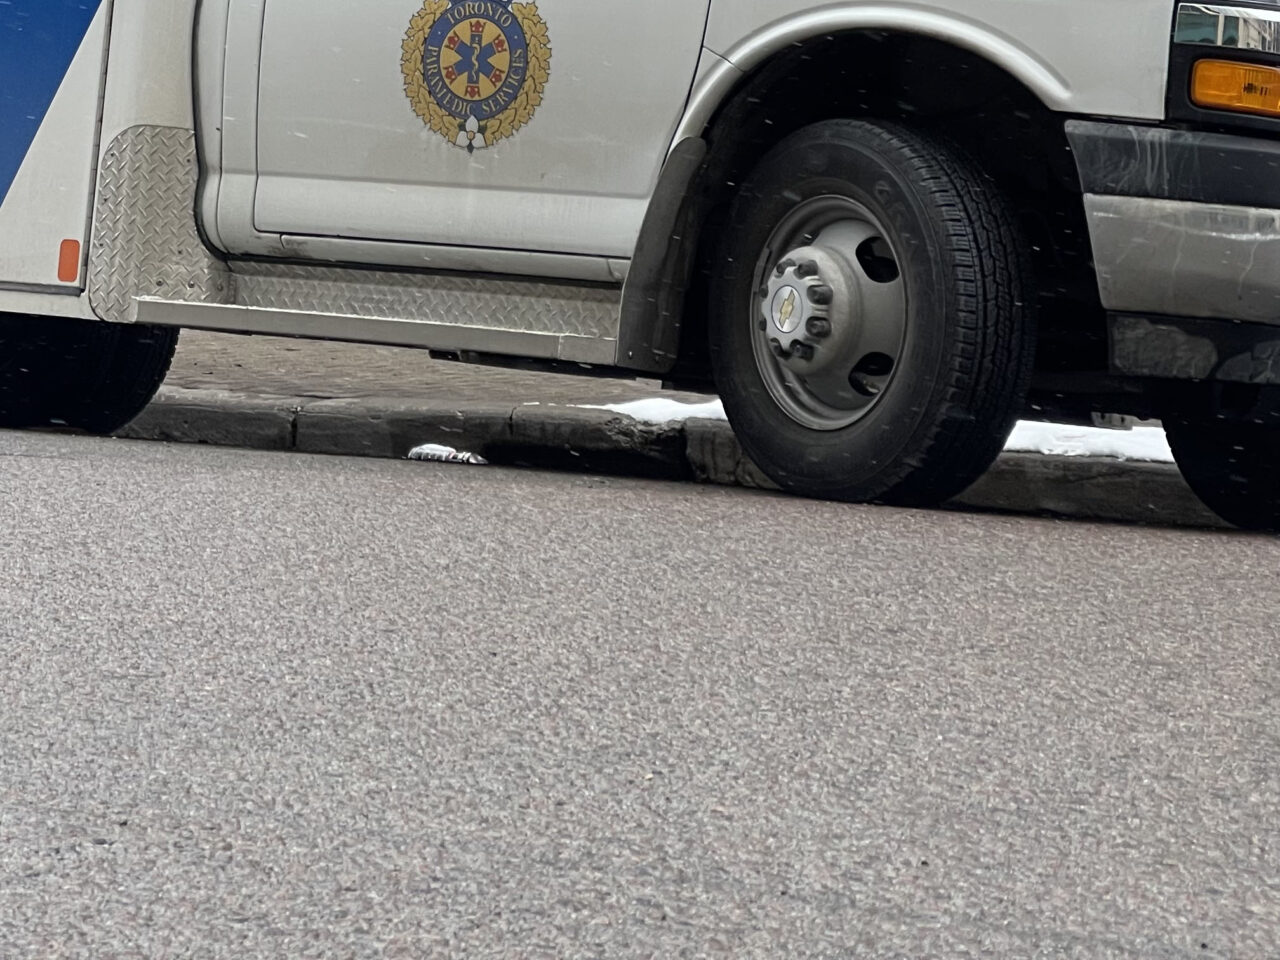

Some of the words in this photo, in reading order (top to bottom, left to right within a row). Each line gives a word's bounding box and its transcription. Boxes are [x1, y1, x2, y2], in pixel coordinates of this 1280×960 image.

[445, 1, 512, 28] TORONTO
[426, 45, 473, 116] PARAMEDIC
[482, 49, 524, 115] SERVICES
